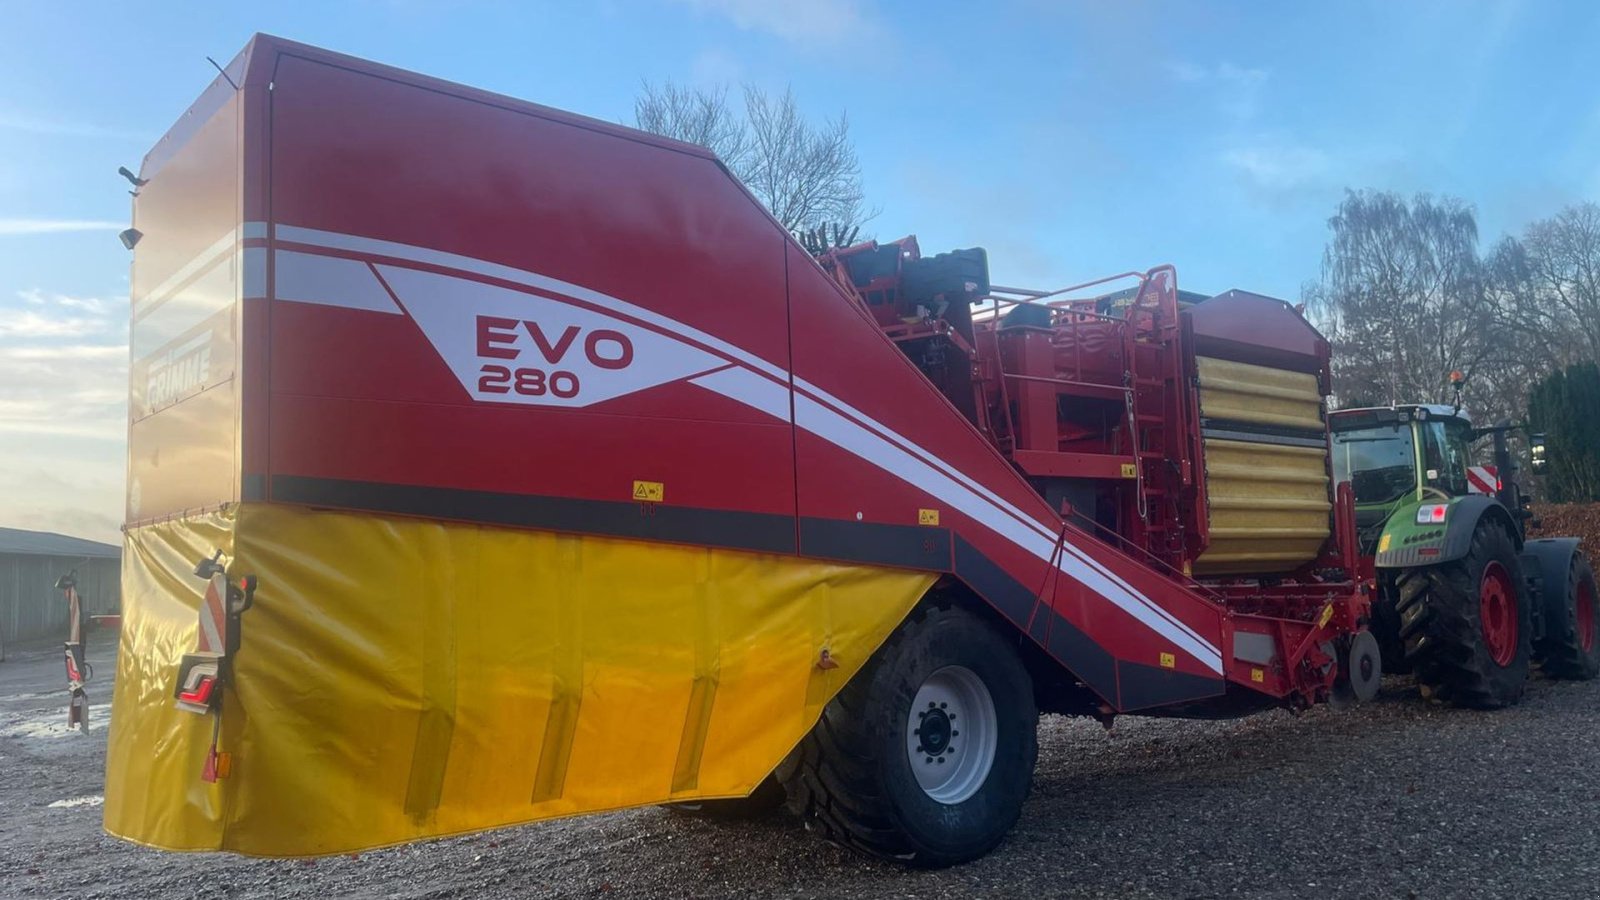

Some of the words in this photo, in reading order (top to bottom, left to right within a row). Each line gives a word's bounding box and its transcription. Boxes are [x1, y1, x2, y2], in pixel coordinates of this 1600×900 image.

[476, 315, 634, 370] EVO
[146, 346, 211, 407] GRIMME
[478, 364, 580, 398] 280
